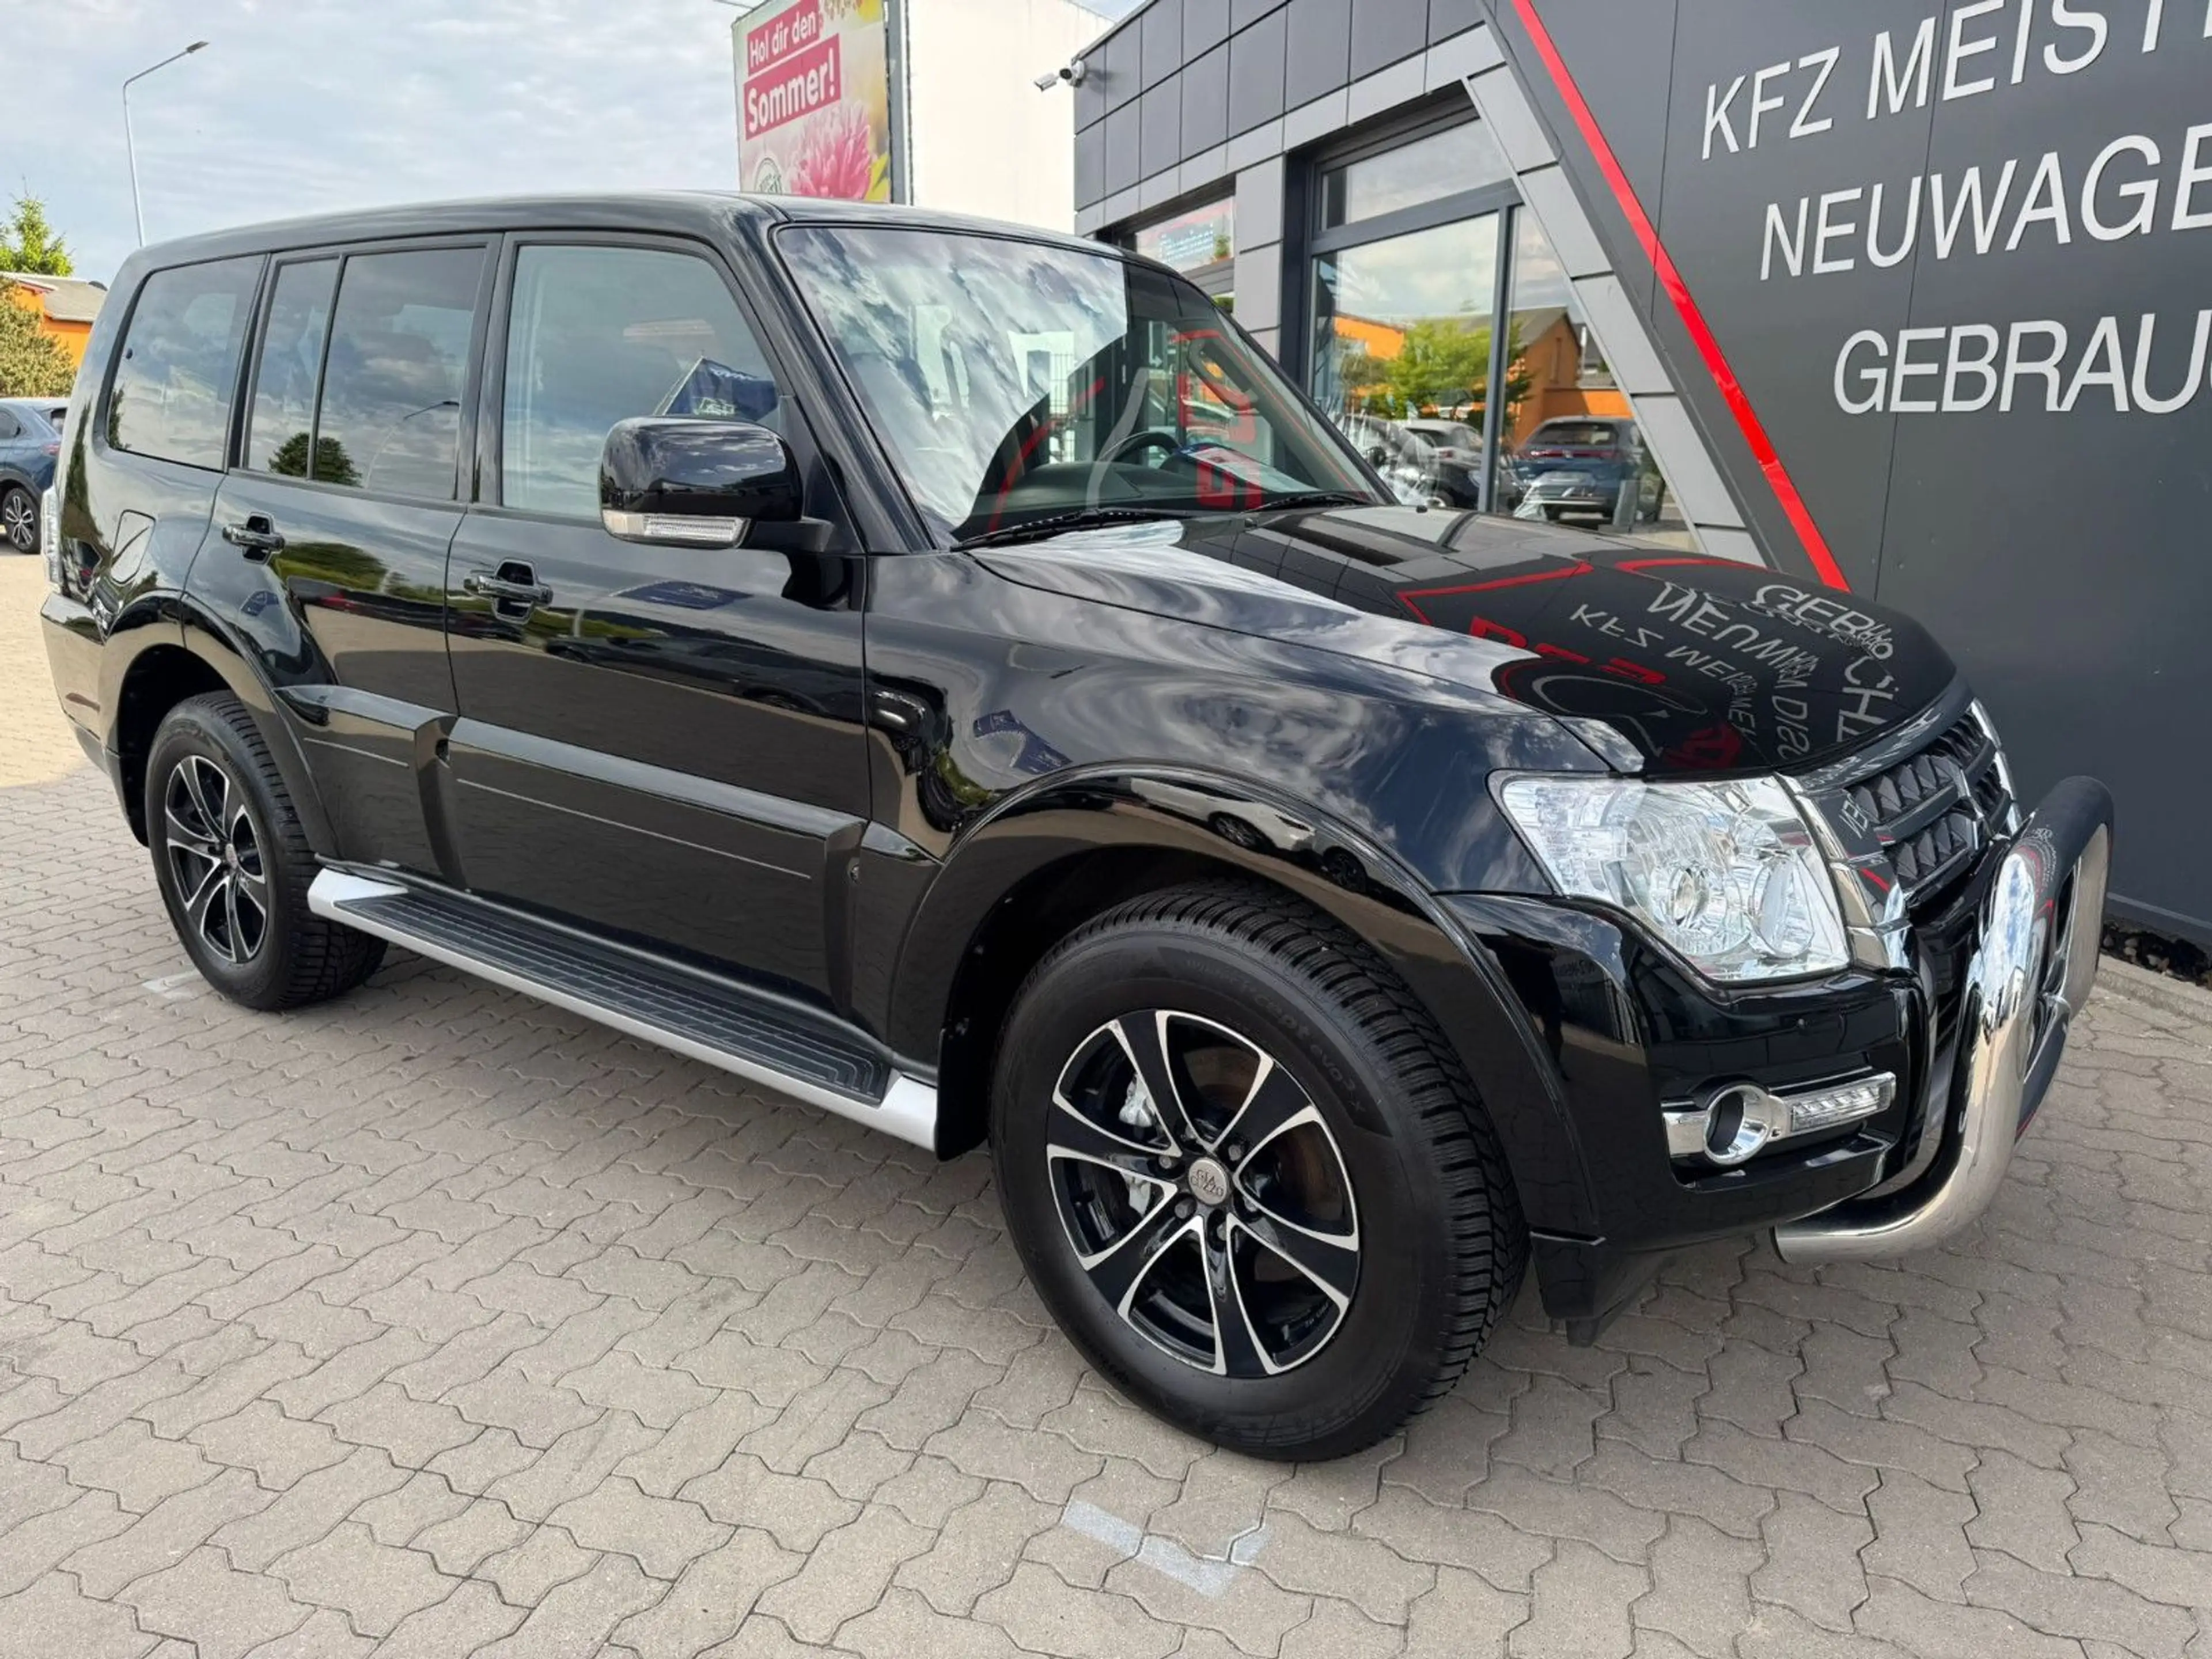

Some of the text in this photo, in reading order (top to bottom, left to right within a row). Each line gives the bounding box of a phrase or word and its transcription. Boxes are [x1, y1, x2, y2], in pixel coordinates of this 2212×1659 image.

[749, 10, 816, 68] Hol dir den
[748, 48, 835, 133] Sommer!
[1702, 46, 1840, 161] KFZ
[1834, 309, 2212, 415] GEBRAU
